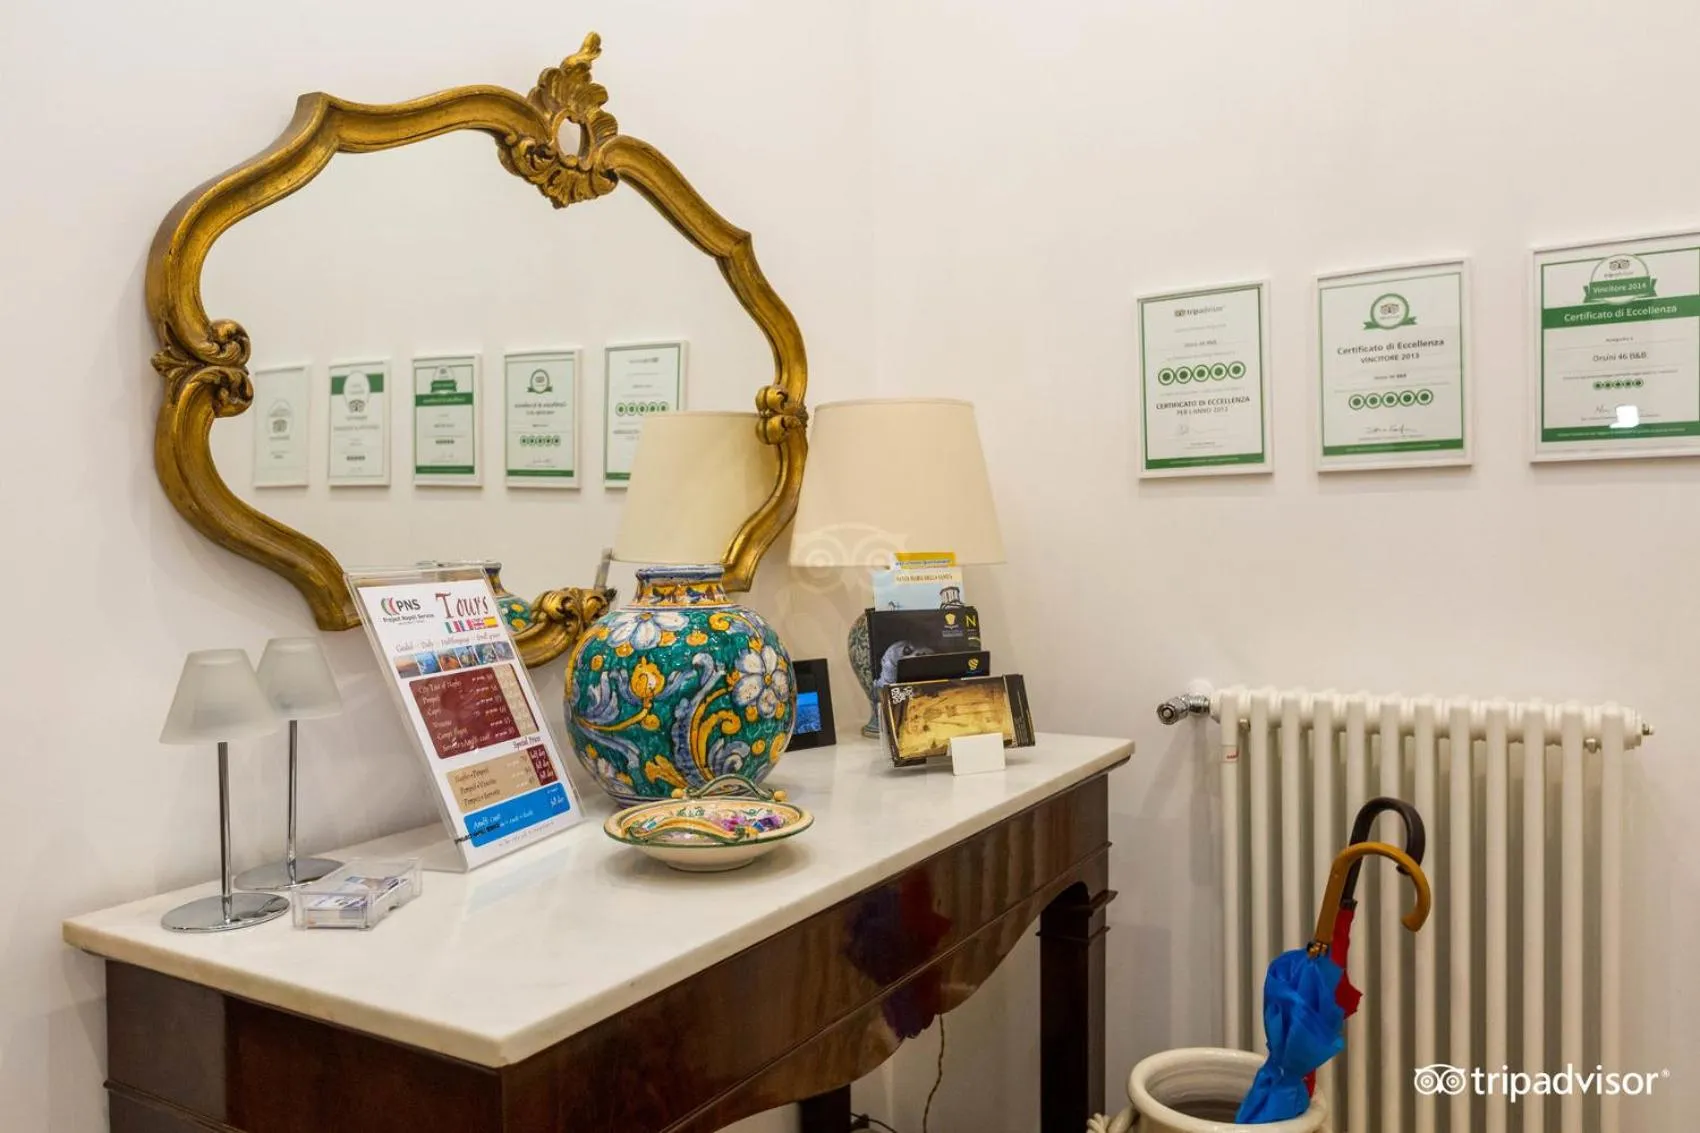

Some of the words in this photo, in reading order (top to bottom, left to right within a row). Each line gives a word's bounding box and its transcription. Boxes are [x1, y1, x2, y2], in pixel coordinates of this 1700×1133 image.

[1564, 310, 1614, 322] Certificato
[1615, 309, 1624, 318] di
[1626, 305, 1678, 317] Eccellenza
[1337, 344, 1384, 355] Certificato
[1386, 342, 1395, 350] di
[1397, 339, 1445, 350] Eccellenza
[1360, 354, 1399, 364] VINCITORE
[1156, 400, 1197, 410] CERTIFICATO
[1207, 396, 1250, 406] ECCELLENZA
[396, 599, 421, 612] PNS
[435, 592, 489, 619] Tours
[965, 614, 977, 627] N
